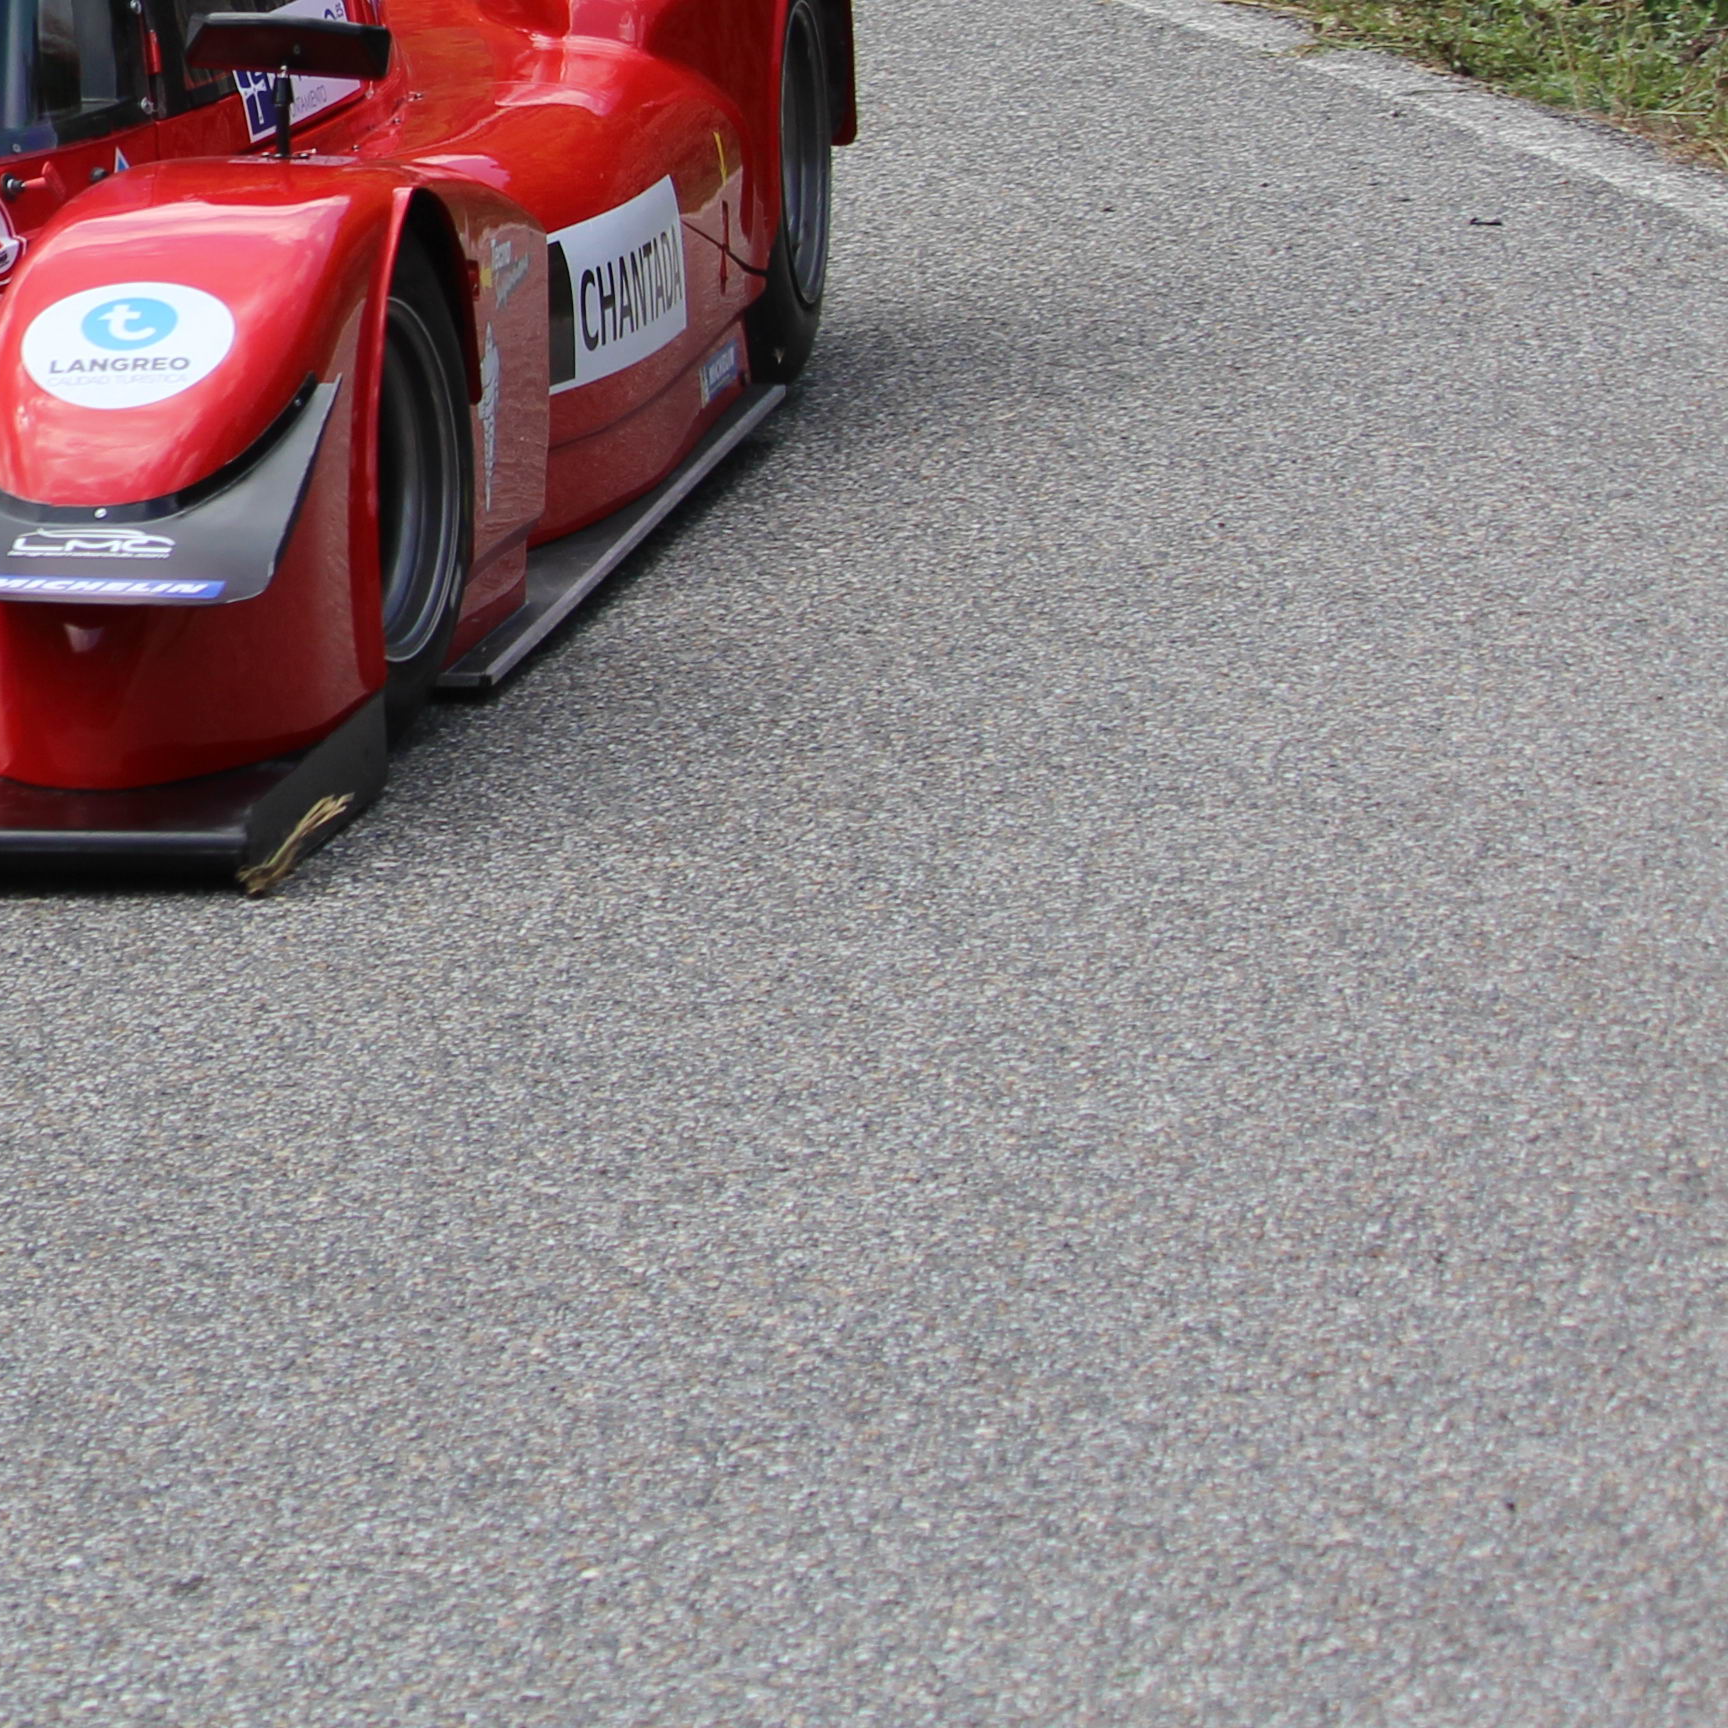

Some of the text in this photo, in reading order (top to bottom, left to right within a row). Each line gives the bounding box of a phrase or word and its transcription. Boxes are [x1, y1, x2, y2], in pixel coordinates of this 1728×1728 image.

[579, 224, 683, 352] CHANTADA
[48, 356, 192, 375] LANGREO
[11, 536, 174, 553] LMC
